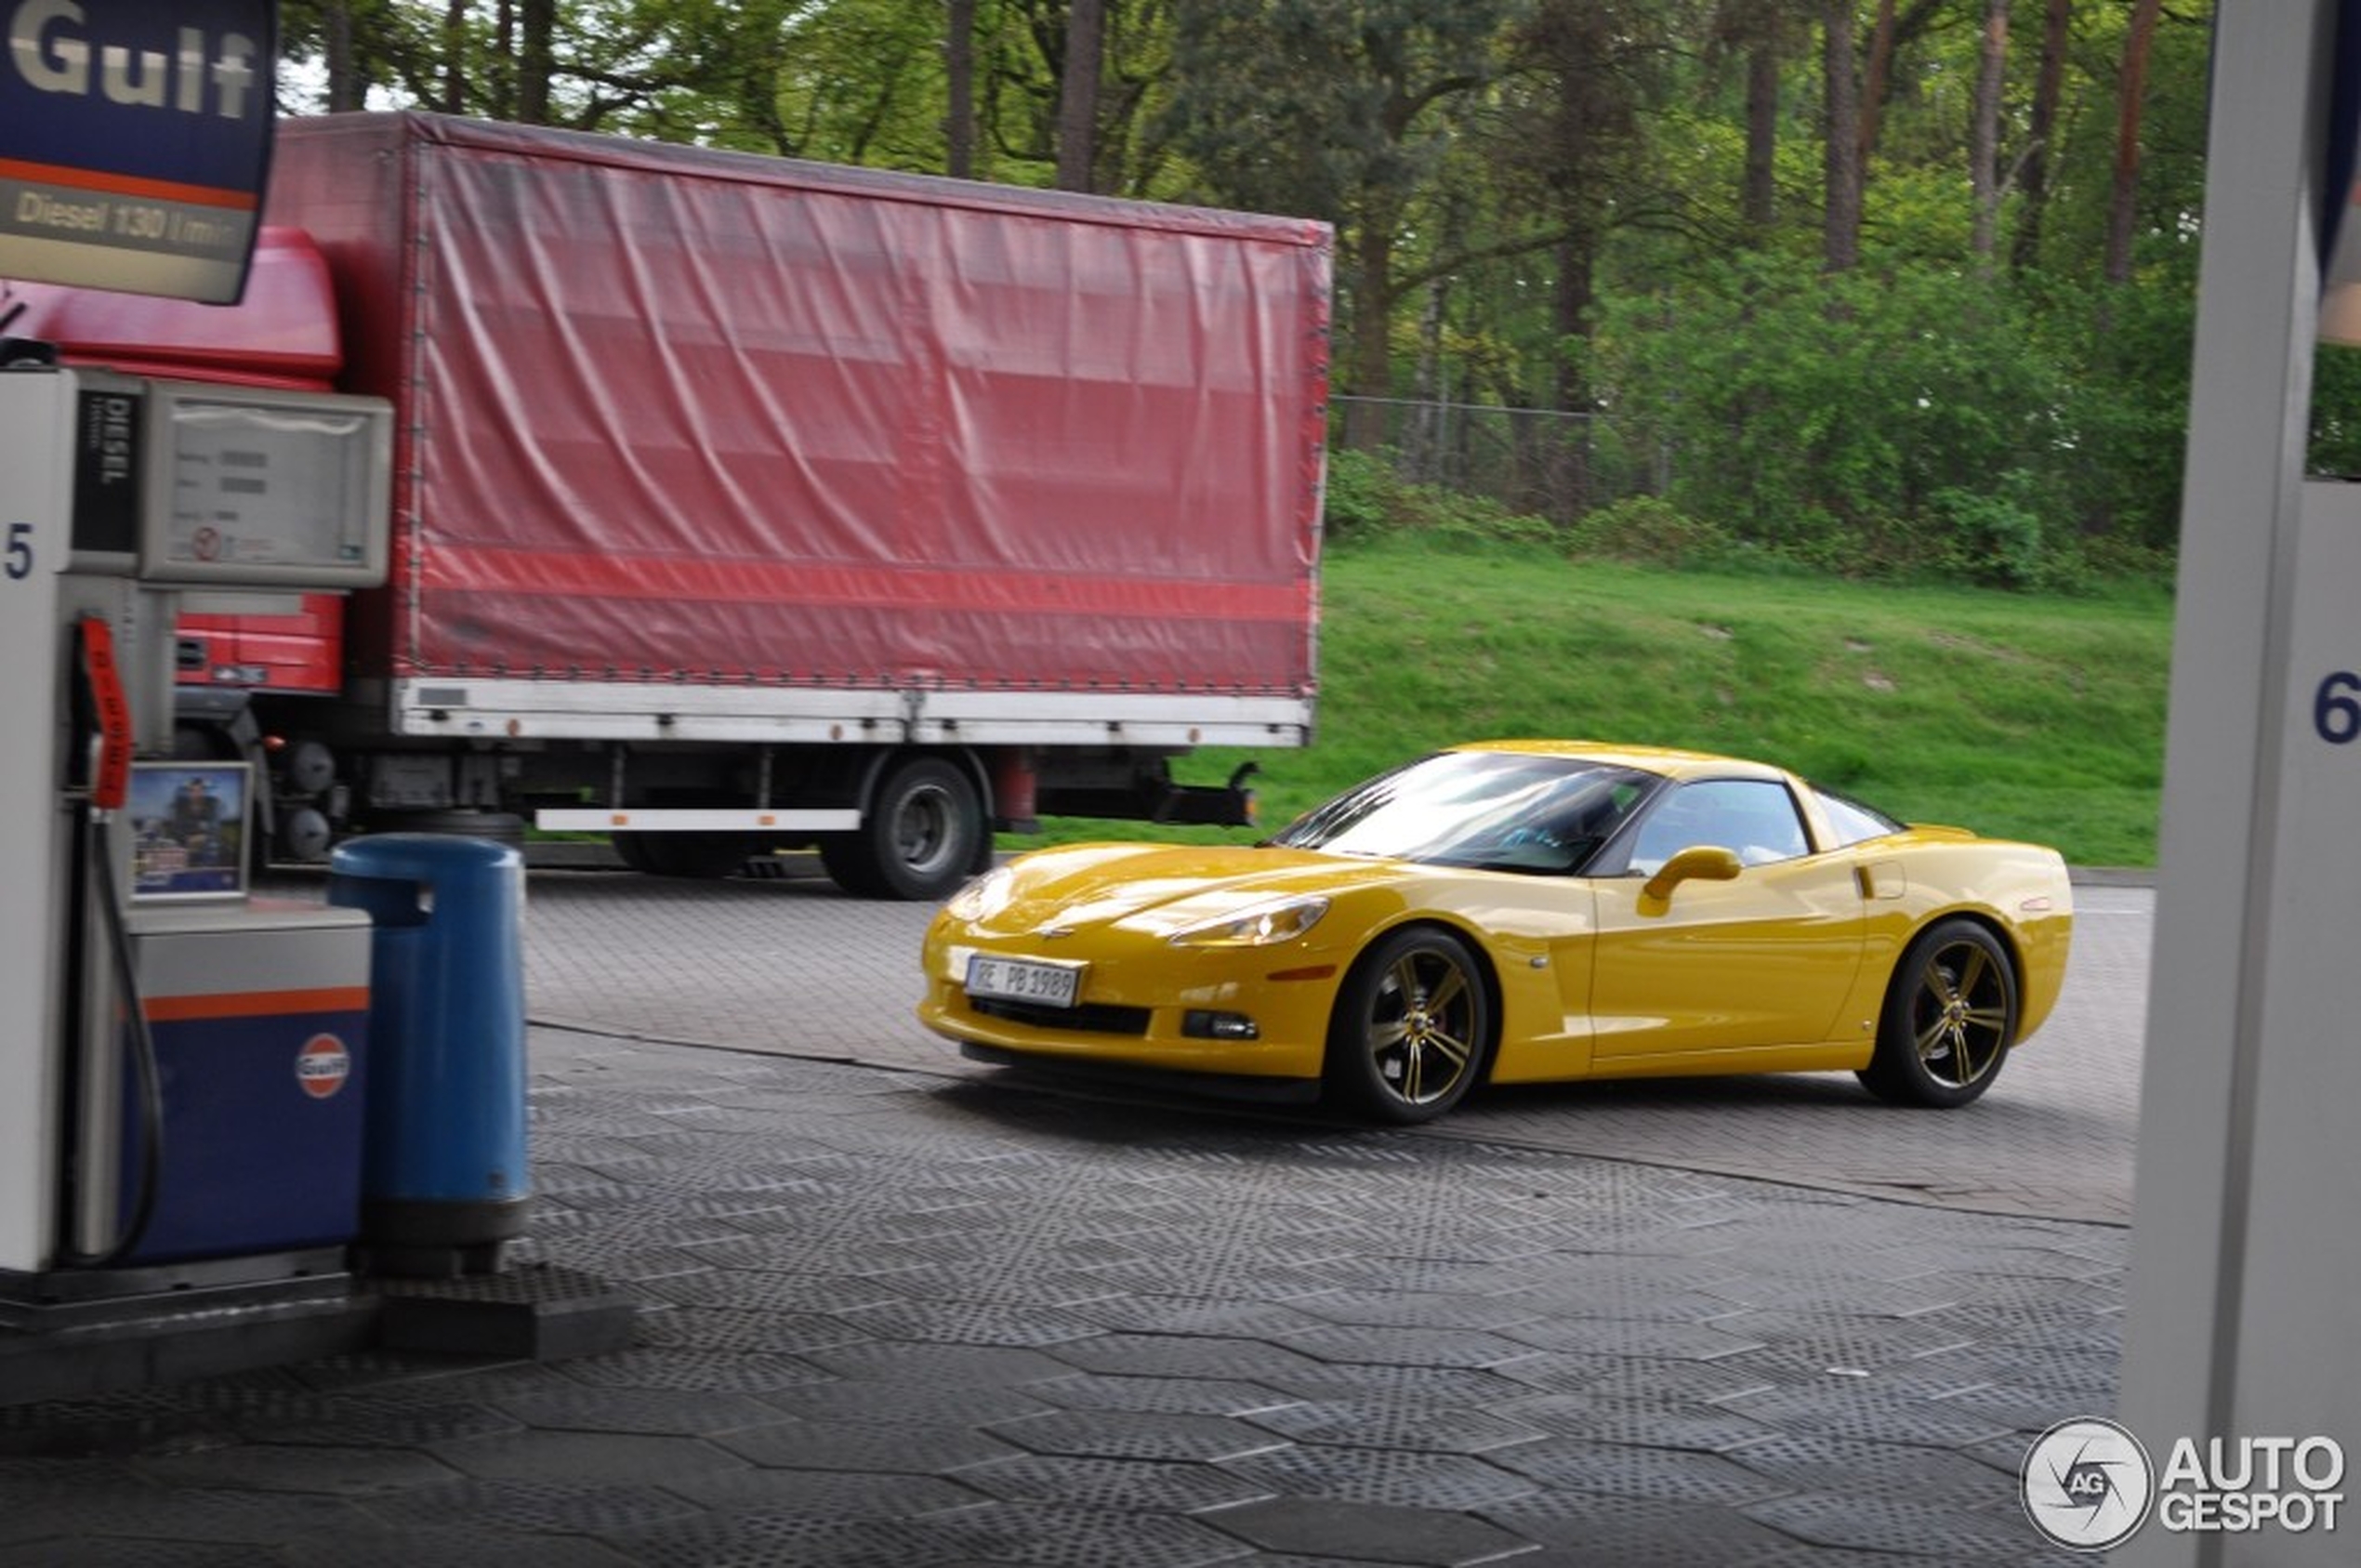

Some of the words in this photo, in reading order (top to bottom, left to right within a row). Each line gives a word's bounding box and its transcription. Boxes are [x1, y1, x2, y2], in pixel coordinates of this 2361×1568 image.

[9, 0, 257, 119] Gulf
[15, 191, 111, 232] Diesel
[112, 204, 166, 239] 130
[101, 398, 130, 484] DIESEL
[6, 522, 33, 579] 5
[2314, 671, 2361, 744] 6
